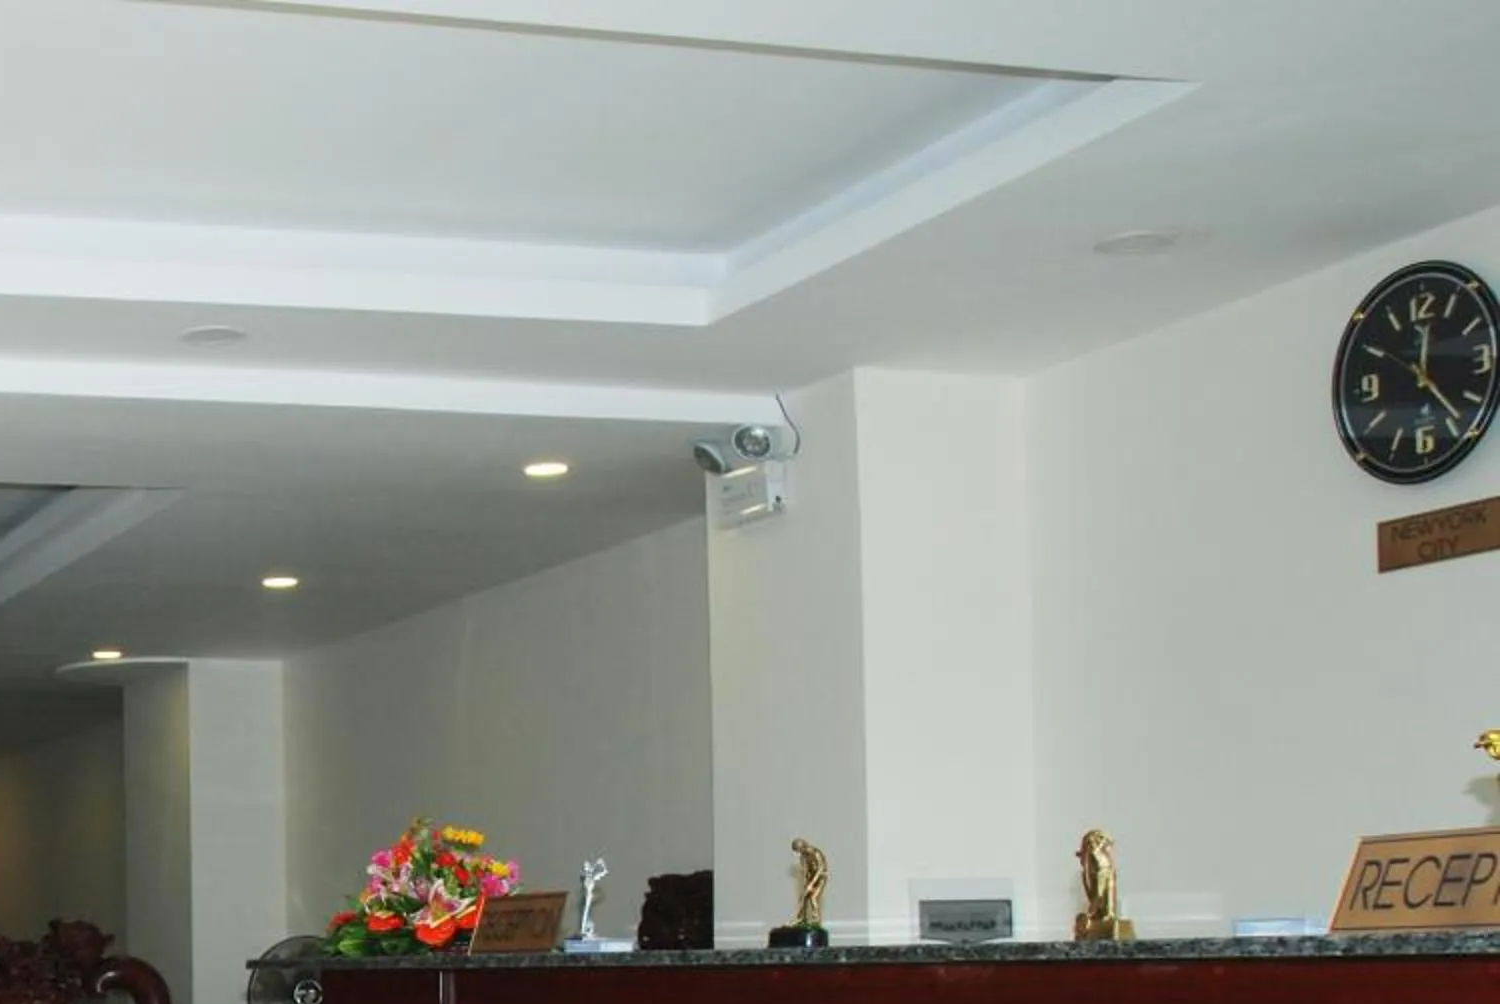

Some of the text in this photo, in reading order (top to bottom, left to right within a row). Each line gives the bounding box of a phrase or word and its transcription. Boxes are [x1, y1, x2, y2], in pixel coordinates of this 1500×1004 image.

[1410, 292, 1436, 322] 12
[1473, 343, 1491, 375] 3
[1361, 374, 1380, 402] 9
[1415, 426, 1436, 455] 6
[1417, 535, 1460, 561] CITY
[1349, 852, 1500, 911] RECEP
